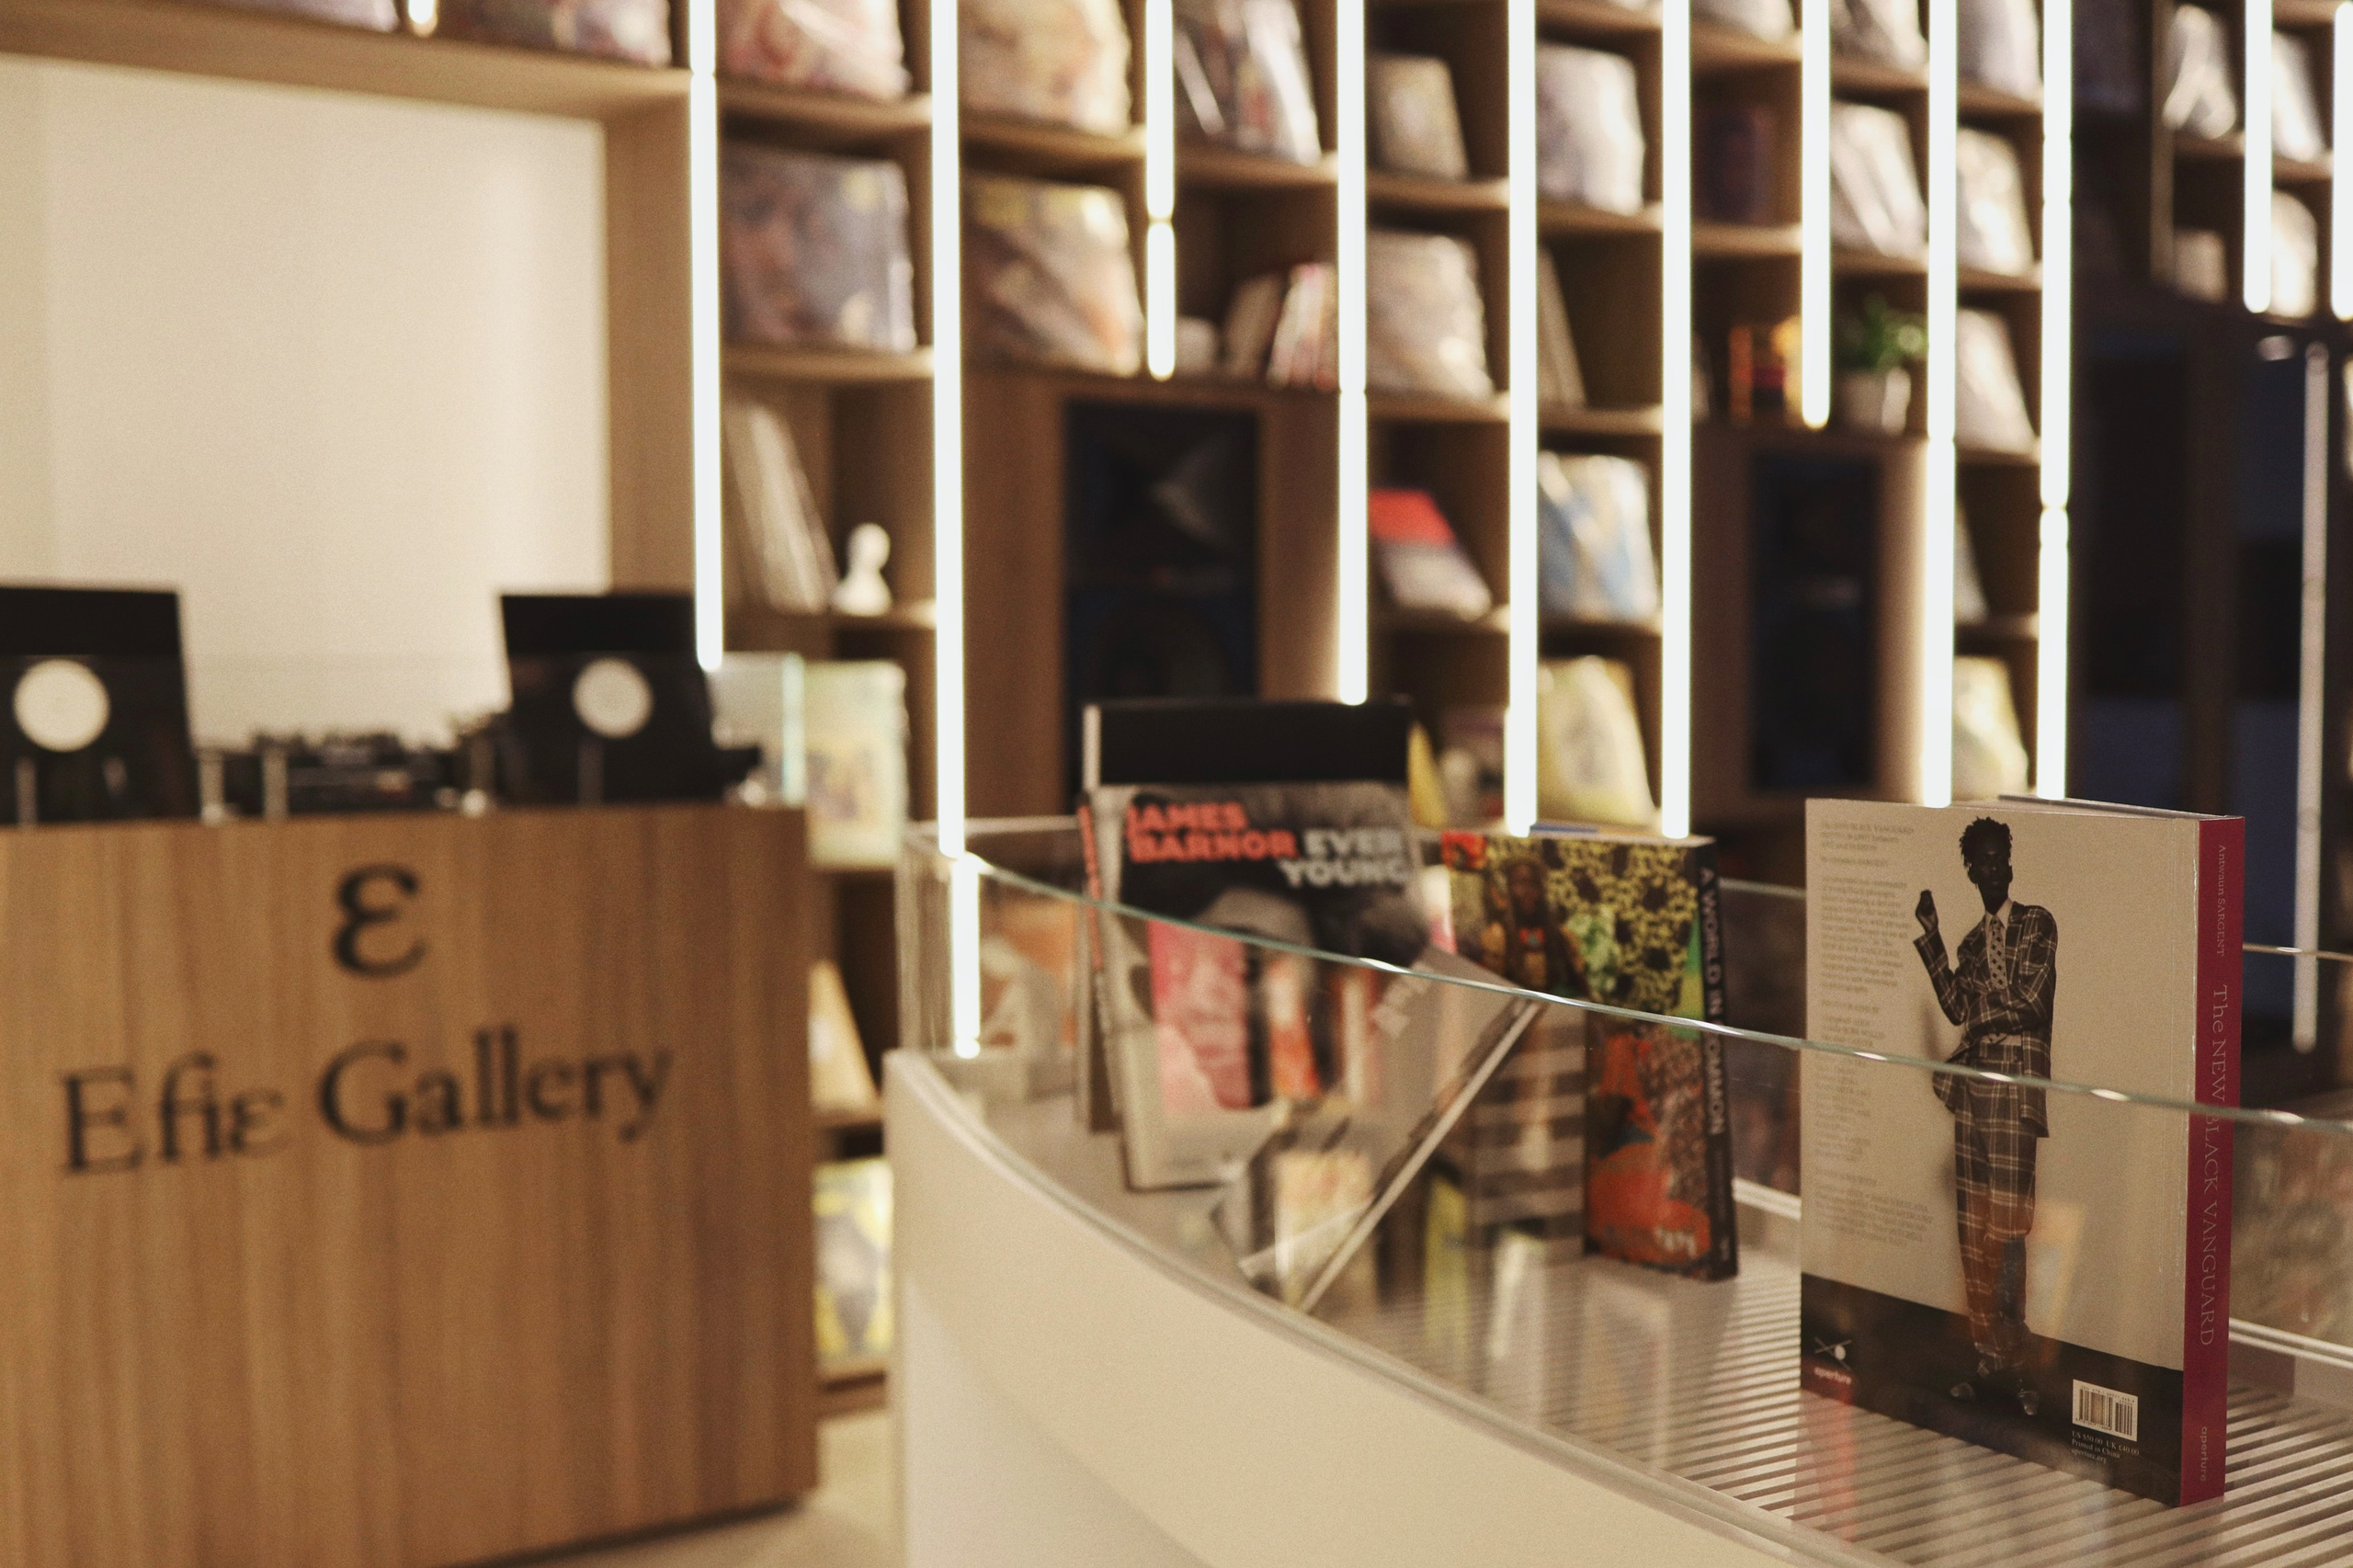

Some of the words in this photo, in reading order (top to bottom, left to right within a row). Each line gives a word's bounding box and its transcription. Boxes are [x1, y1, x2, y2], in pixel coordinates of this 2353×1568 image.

[1130, 830, 1300, 862] BARNOR
[1304, 828, 1404, 857] EVER
[2217, 845, 2226, 895] Antwaun
[1279, 858, 1414, 888] YOUNG
[1700, 867, 1716, 885] A
[1700, 890, 1722, 984] WORLD
[2216, 898, 2226, 956] SARGENT
[1707, 989, 1723, 1015] IN
[2211, 984, 2228, 1033] The
[316, 1022, 674, 1145] Gallery
[1704, 1018, 1726, 1135] OMMON
[2211, 1039, 2226, 1102] NEW
[2204, 1113, 2220, 1192] BLACK
[2200, 1200, 2218, 1346] VANGUARD
[2072, 1431, 2081, 1439] US
[2106, 1440, 2117, 1450] UK
[2072, 1438, 2094, 1450] Printed
[2102, 1448, 2120, 1459] China
[2072, 1449, 2107, 1464] aperture.org
[2200, 1426, 2208, 1482] aperture
